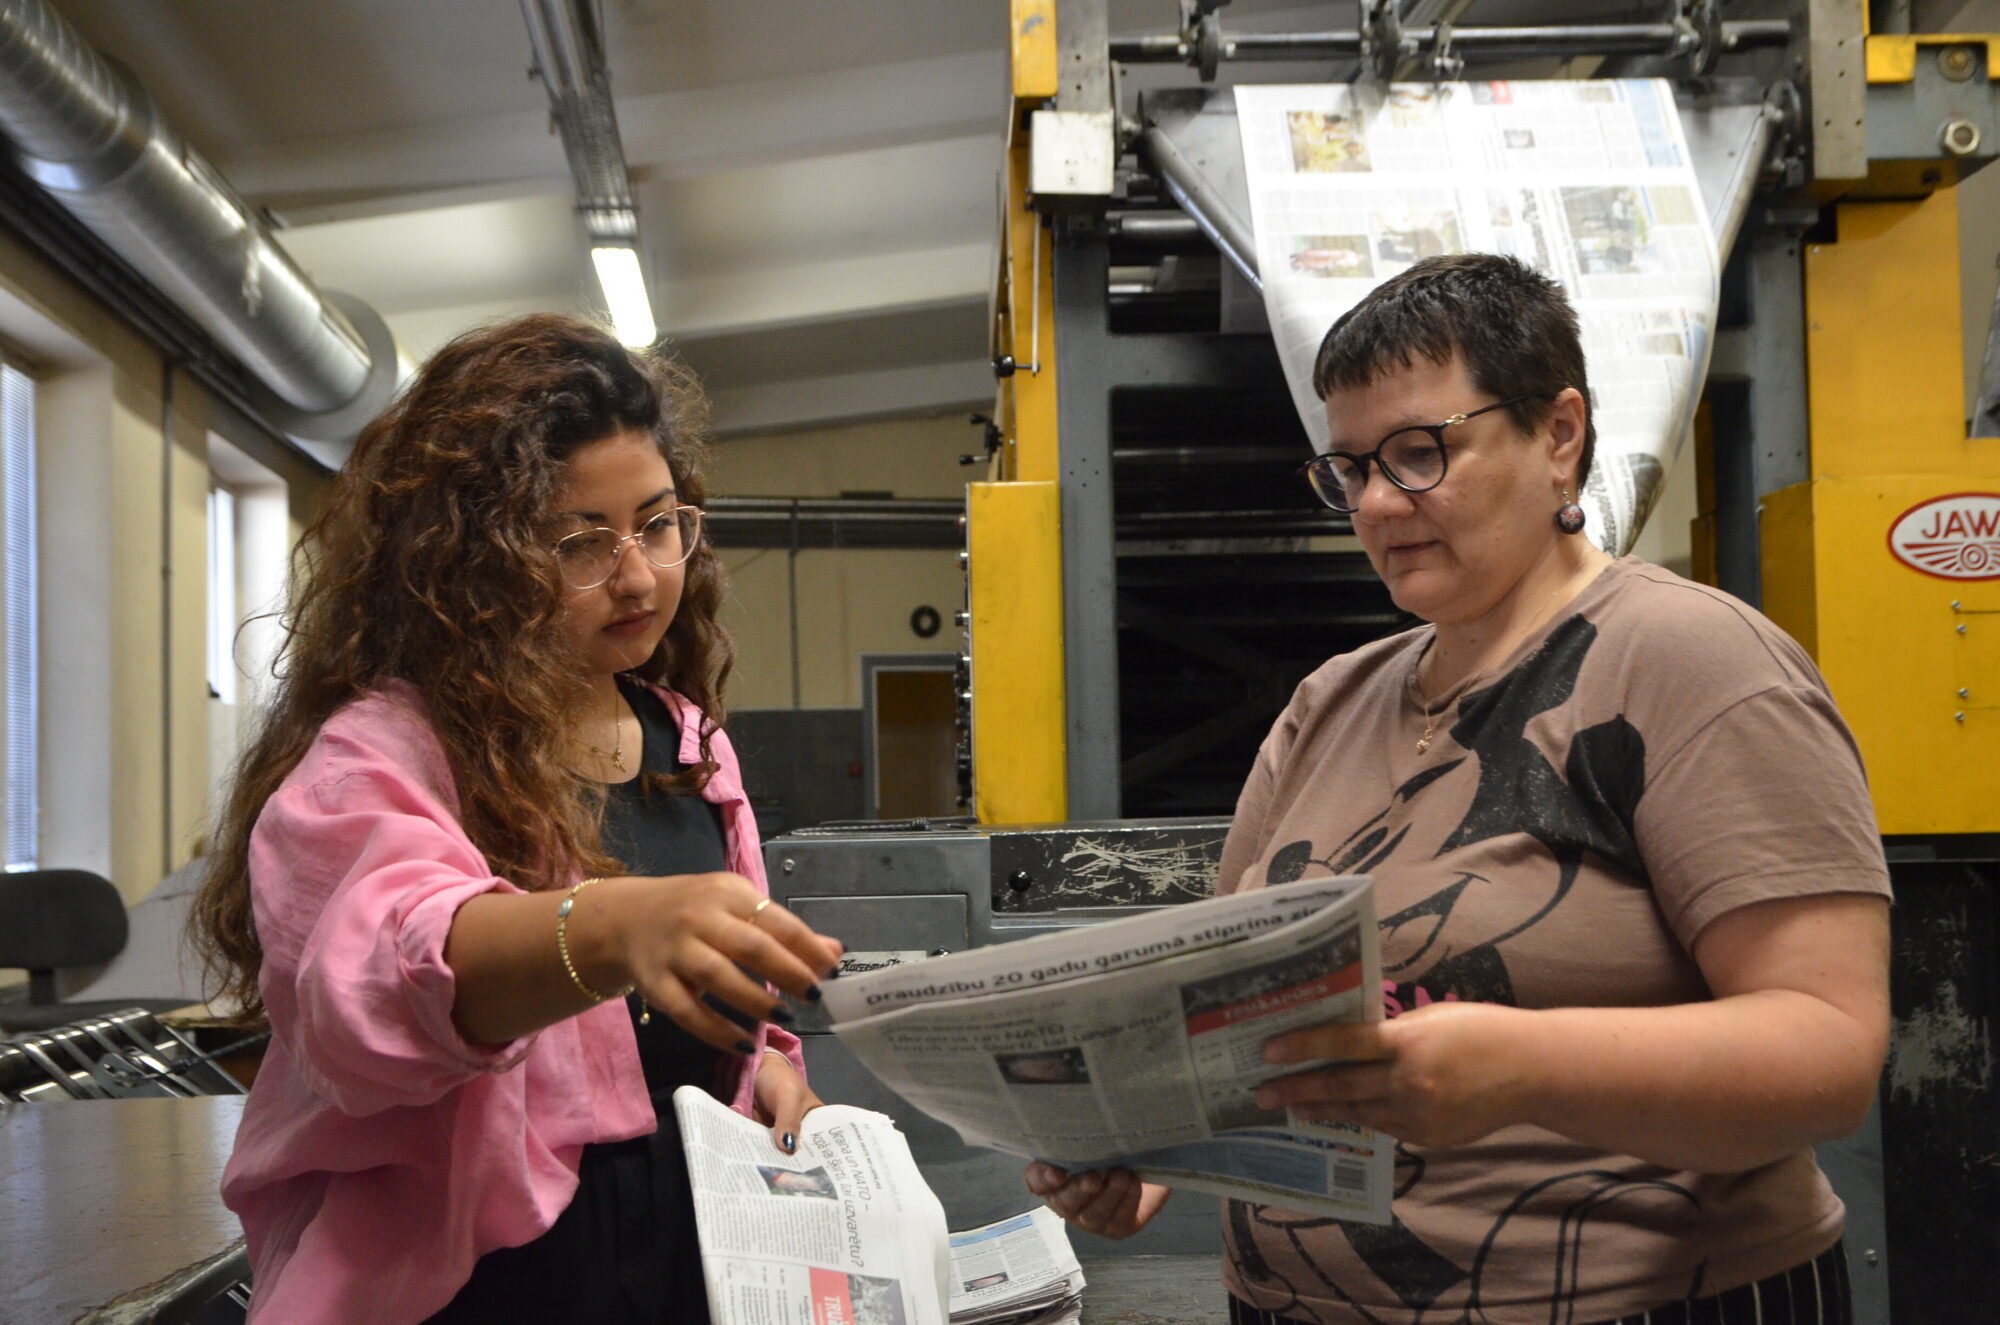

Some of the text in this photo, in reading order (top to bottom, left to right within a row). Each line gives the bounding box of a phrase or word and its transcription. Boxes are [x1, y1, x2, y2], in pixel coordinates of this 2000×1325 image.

[1921, 510, 2000, 539] JAW
[993, 972, 1022, 988] 20
[1030, 957, 1088, 981] gadu
[1094, 936, 1185, 968] garumā
[1192, 913, 1283, 944] stiprina
[821, 1148, 839, 1159] vai
[845, 1155, 858, 1168] un
[840, 1183, 855, 1199] lai
[851, 1169, 871, 1201] NATO
[845, 1199, 865, 1268] uzvarētu?
